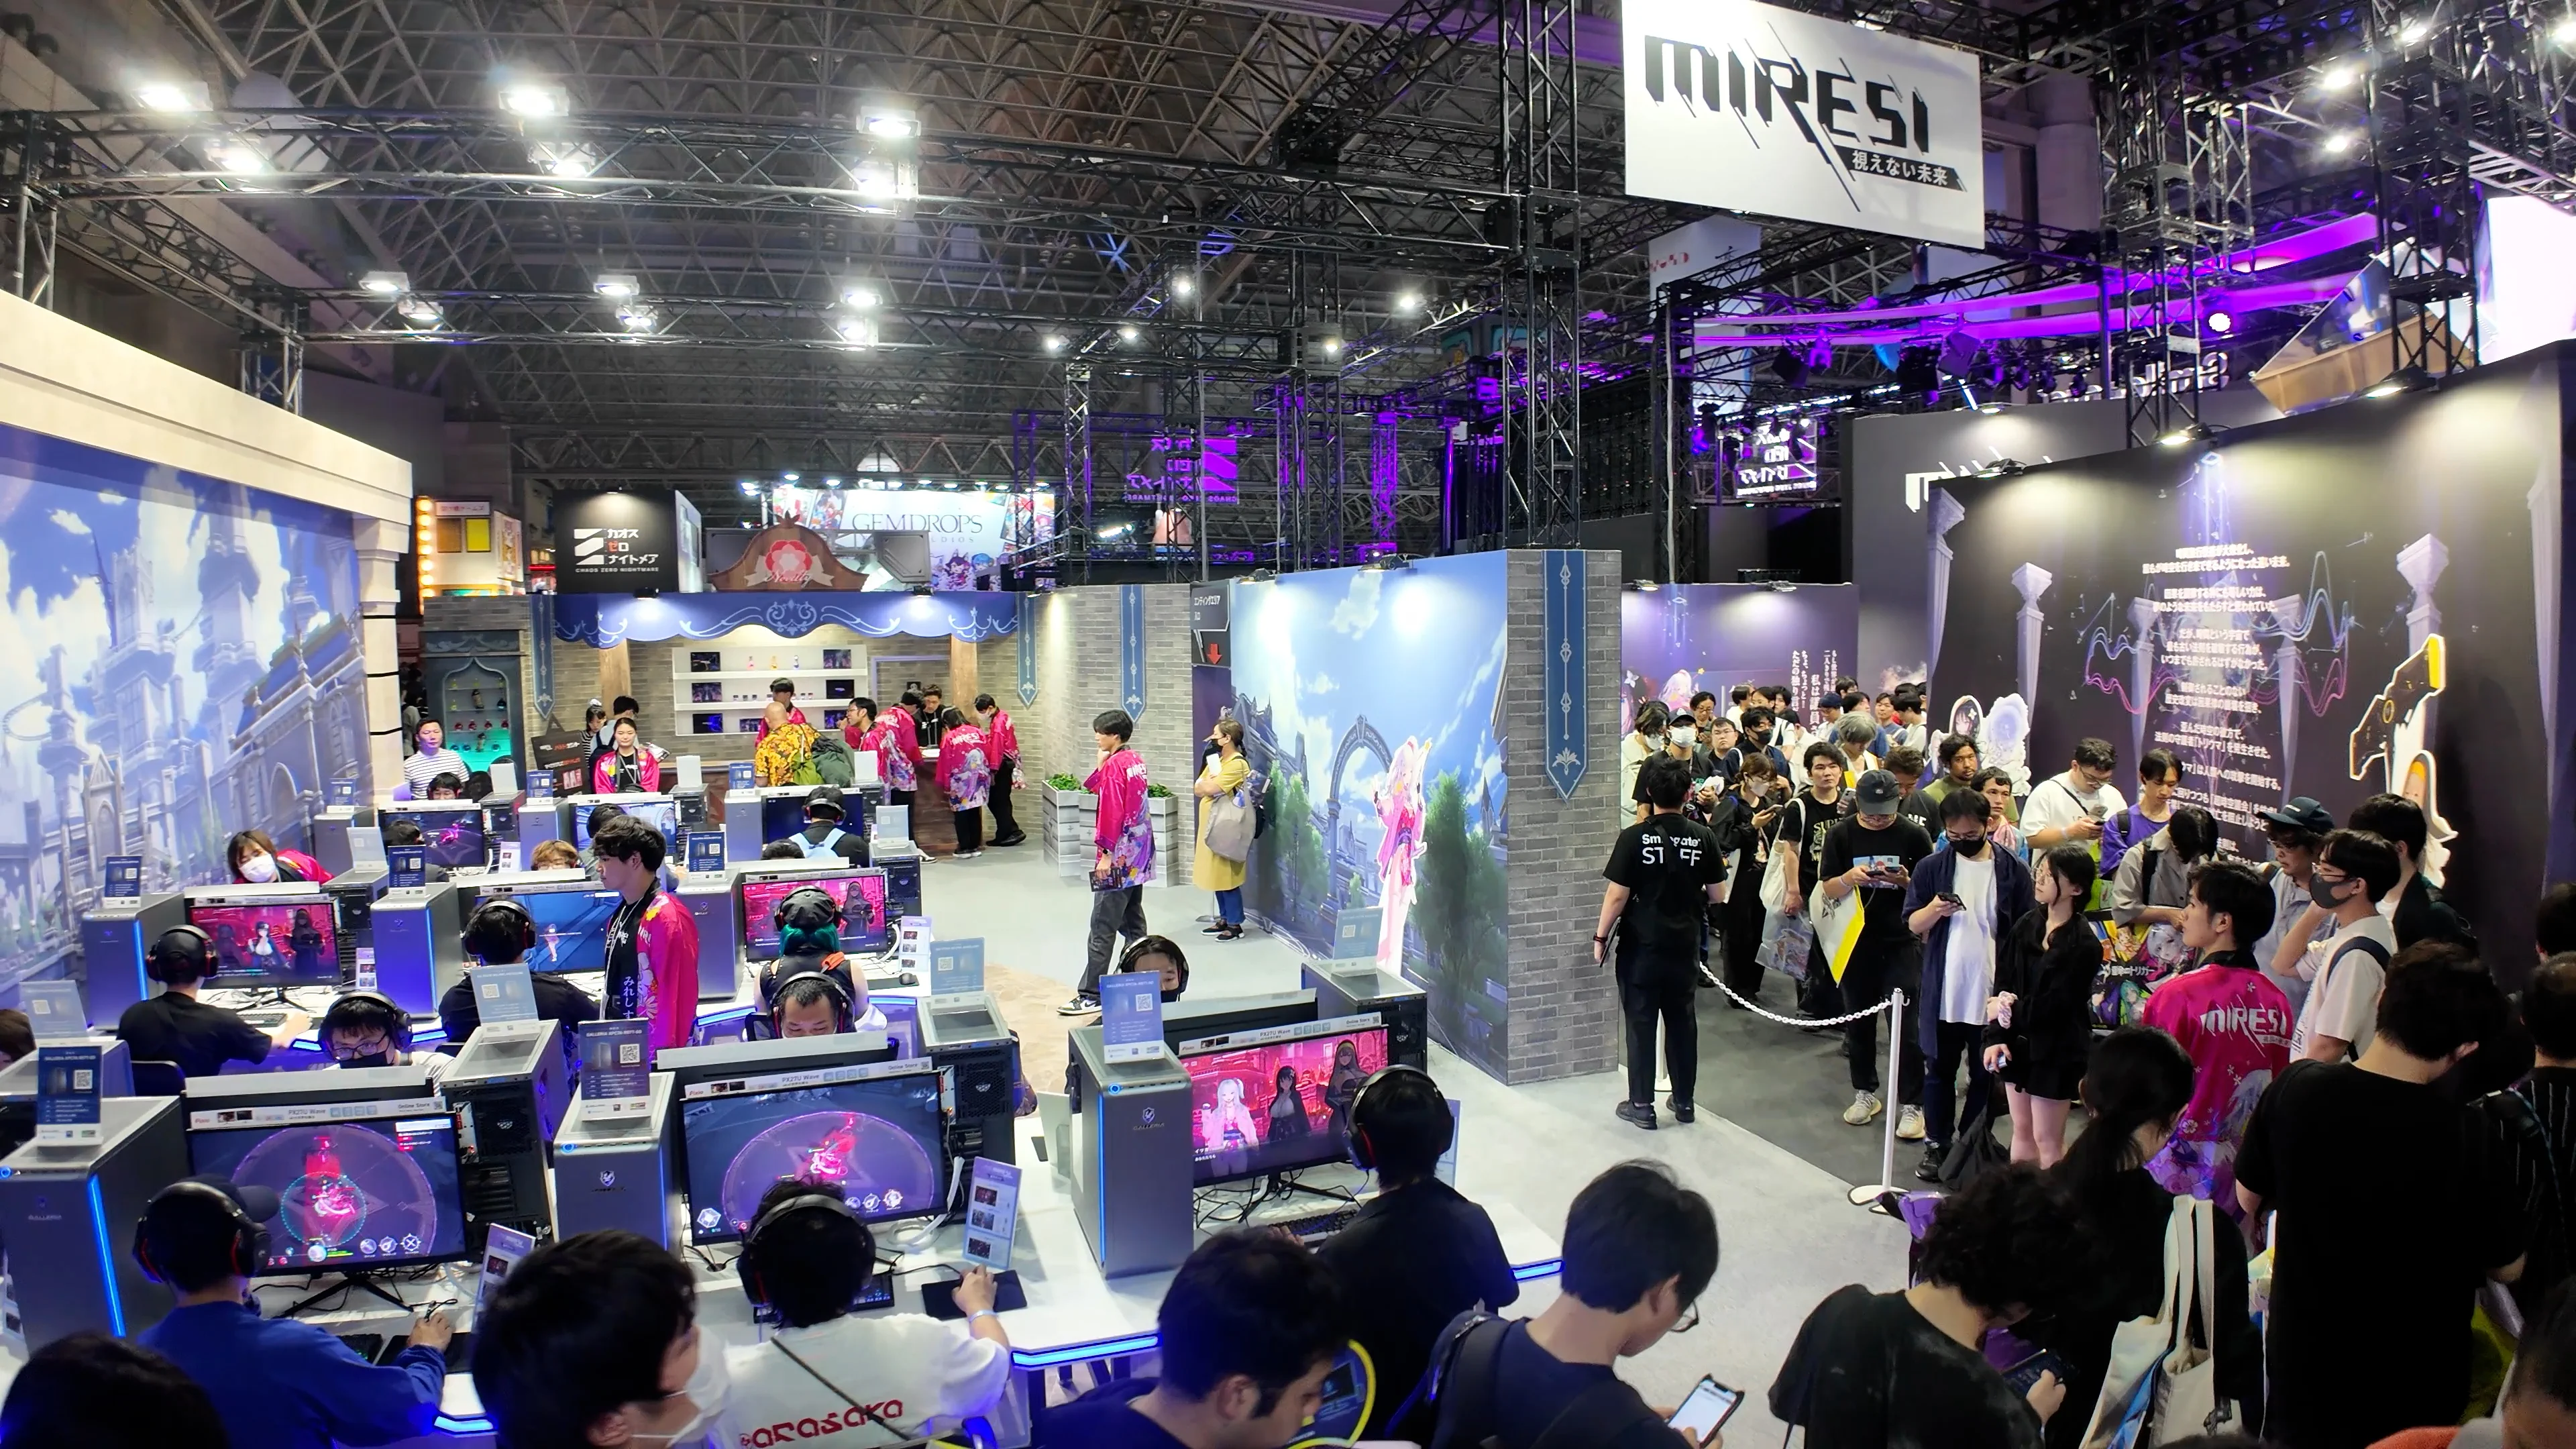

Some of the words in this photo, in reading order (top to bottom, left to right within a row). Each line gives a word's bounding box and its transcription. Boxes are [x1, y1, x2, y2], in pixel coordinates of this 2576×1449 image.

[1644, 28, 1929, 164] MIRESI
[1851, 149, 1948, 186] 視えない未来
[852, 513, 983, 533] GEMDROPS
[607, 529, 639, 539] カオス
[608, 541, 629, 552] ゼロ
[608, 554, 659, 565] ナイトメア
[1642, 834, 1699, 847] Smgate
[1642, 847, 1703, 866] STFF
[2200, 1000, 2287, 1043] MIRESI
